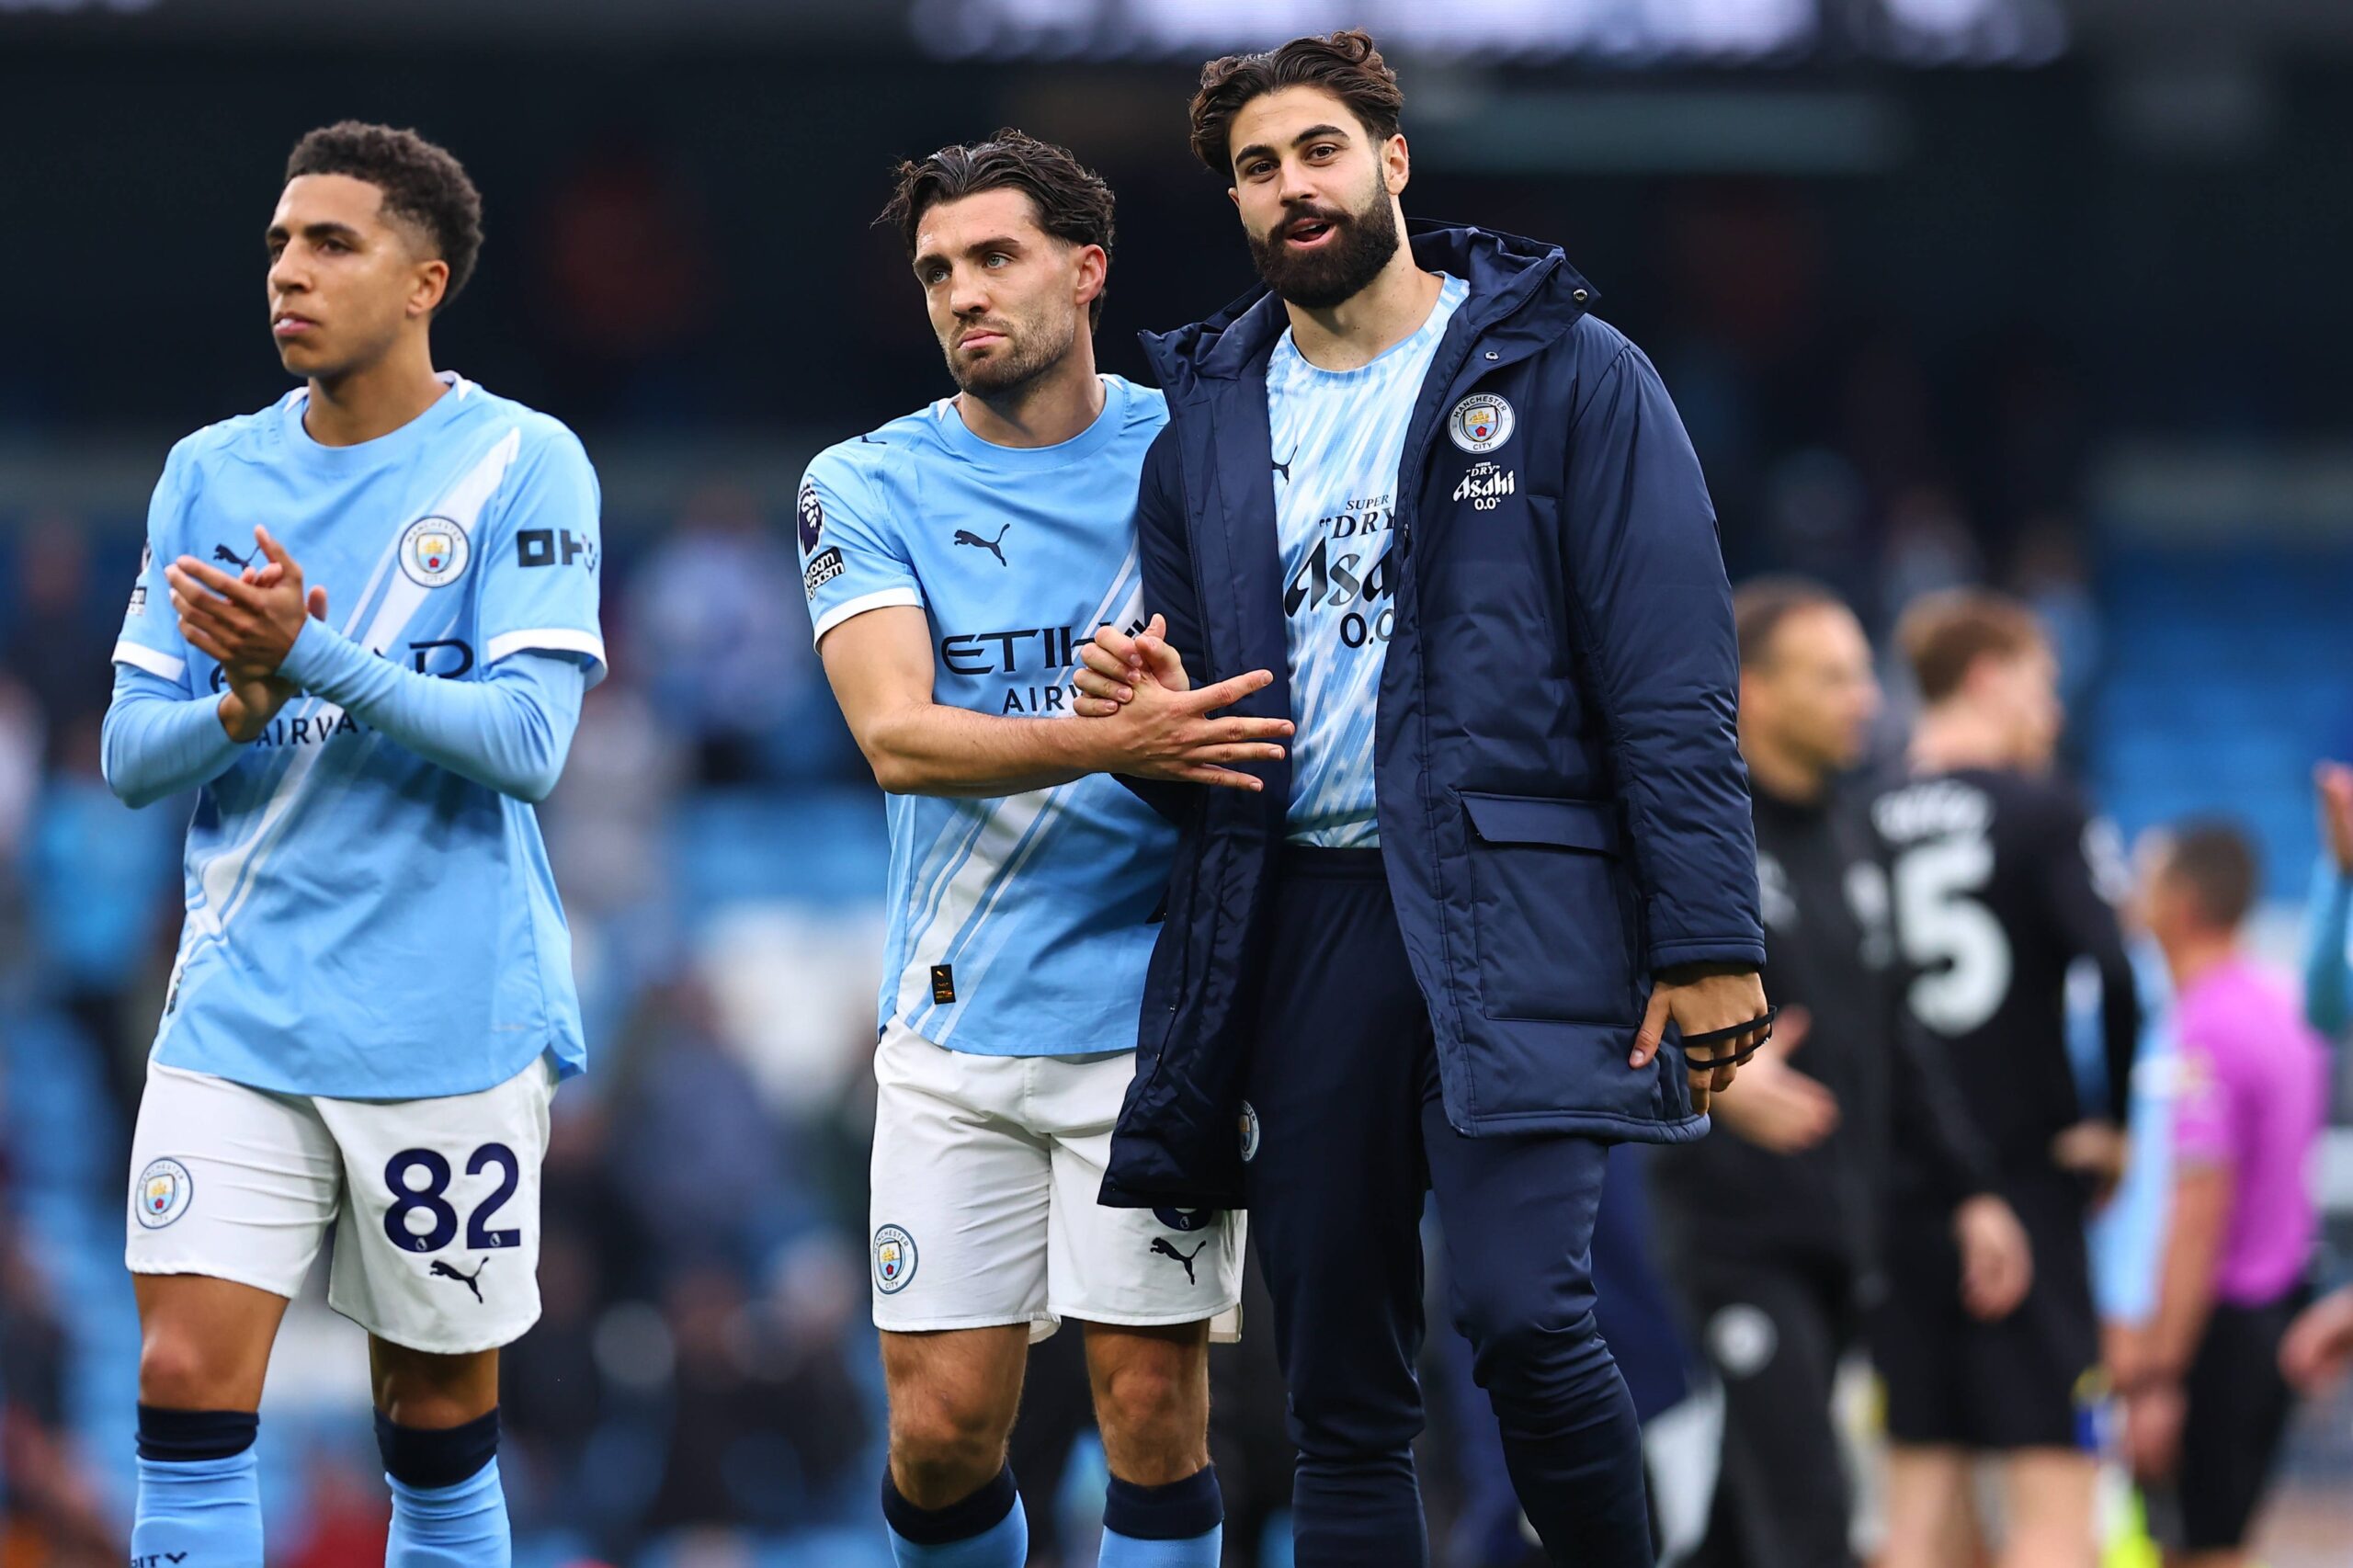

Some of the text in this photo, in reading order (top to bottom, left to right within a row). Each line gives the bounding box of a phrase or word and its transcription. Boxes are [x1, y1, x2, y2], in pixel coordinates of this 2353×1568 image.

[1453, 395, 1507, 418] MANCHESTER
[1472, 442, 1493, 450] CITY
[1453, 470, 1516, 502] Asahi
[1345, 494, 1390, 511] SUPER
[940, 619, 1146, 675] ETIH
[383, 1142, 521, 1253] 82
